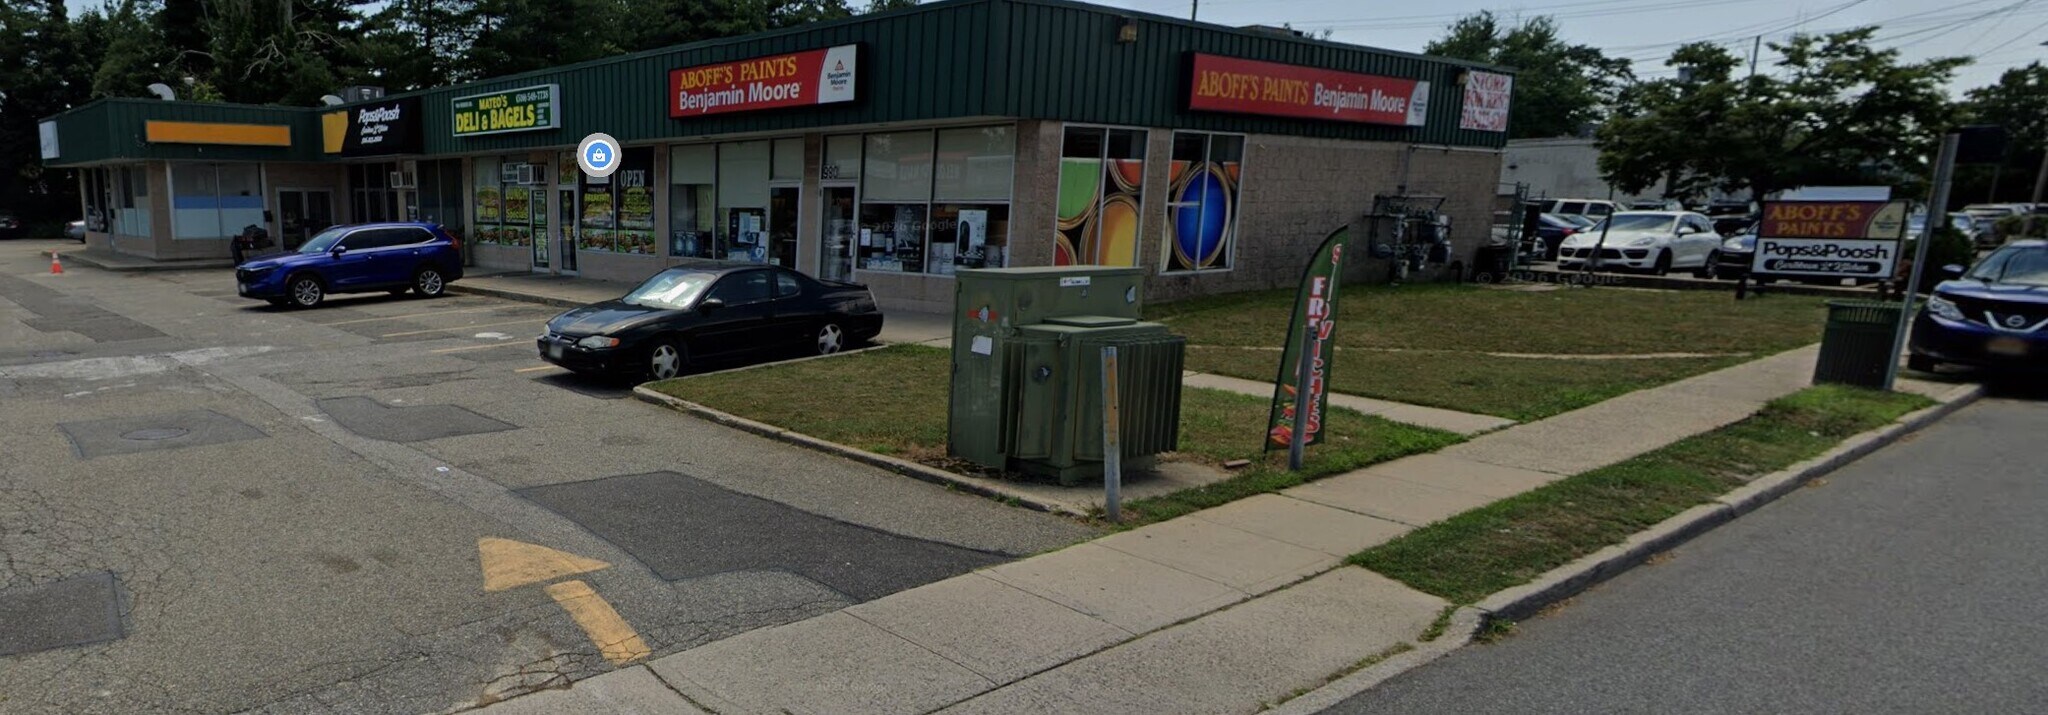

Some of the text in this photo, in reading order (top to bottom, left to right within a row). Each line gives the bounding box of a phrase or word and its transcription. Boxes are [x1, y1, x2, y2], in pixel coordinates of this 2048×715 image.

[680, 56, 798, 90] ABOFF'S PAINTS
[827, 70, 851, 80] Benjamin
[830, 78, 847, 86] Moore
[679, 81, 801, 112] Benjamin Moore
[1197, 70, 1406, 113] ABOFF'S PAINTS Benjamin Moore
[479, 94, 508, 111] MATEO'S
[358, 103, 400, 125] Pops&Poosh
[456, 111, 479, 133] DELI
[481, 114, 489, 131] &
[490, 104, 535, 130] BAGELS
[620, 169, 645, 187] OPEN
[1770, 205, 1860, 221] ABOFF'S
[1777, 222, 1847, 236] PAINTS
[1763, 242, 1888, 260] Pops&Poosh
